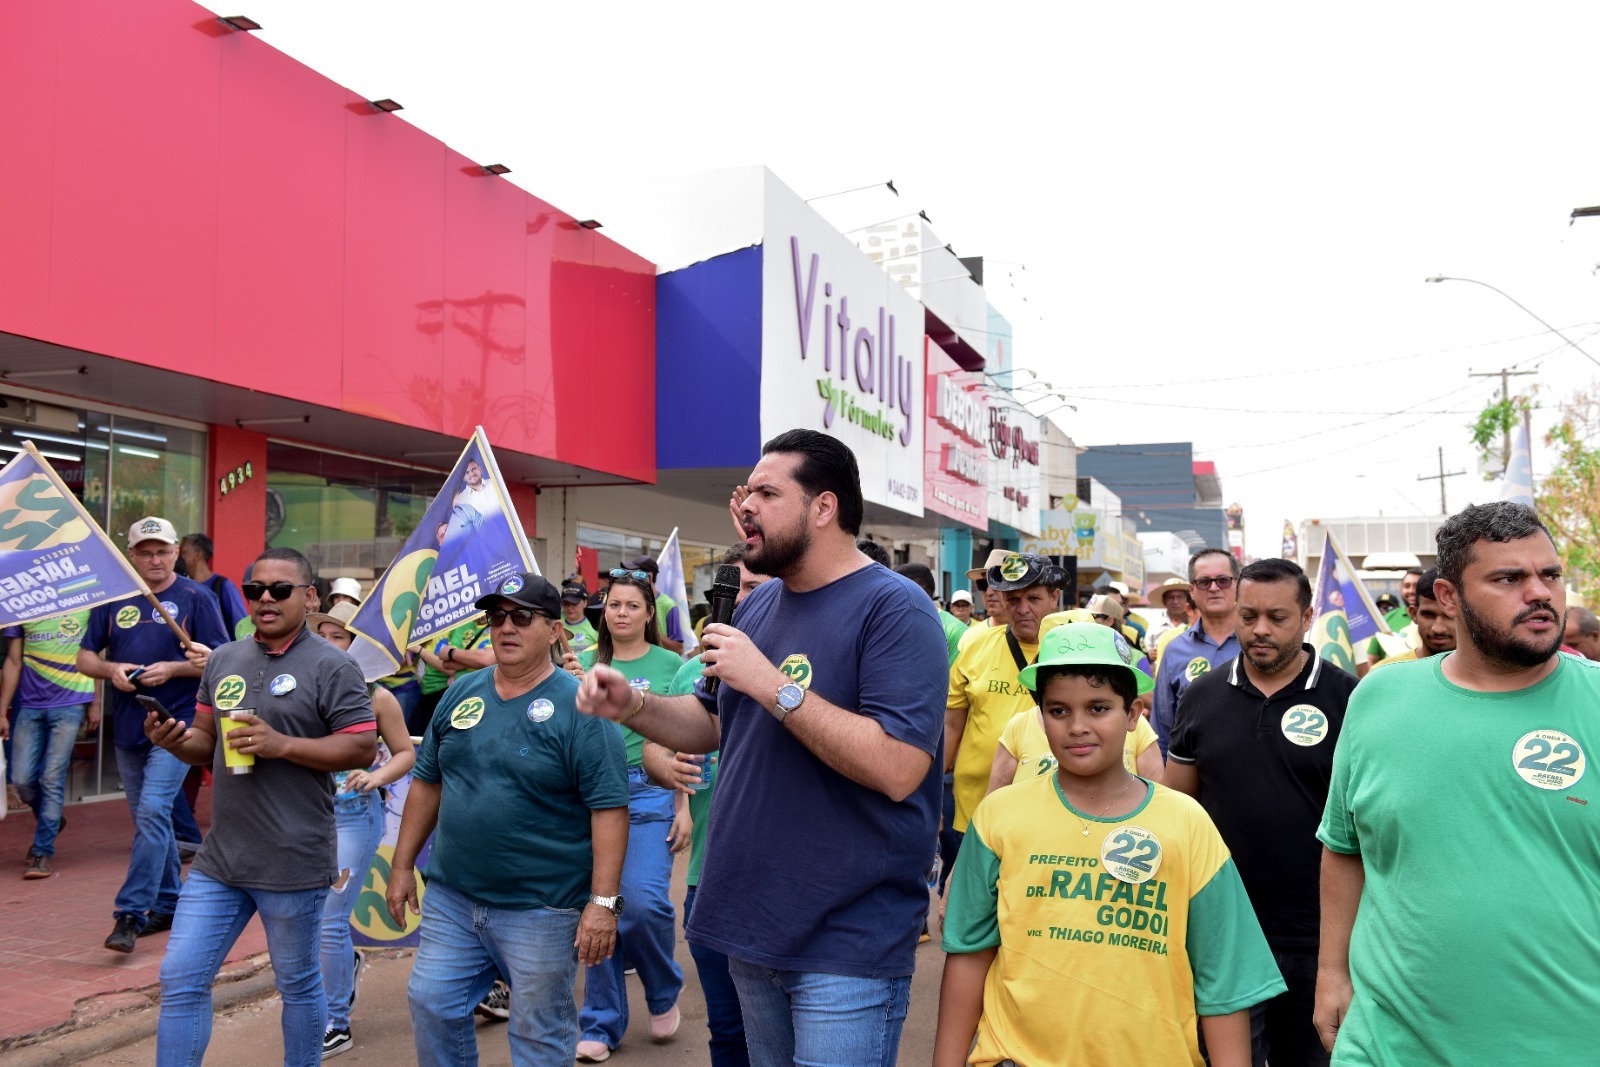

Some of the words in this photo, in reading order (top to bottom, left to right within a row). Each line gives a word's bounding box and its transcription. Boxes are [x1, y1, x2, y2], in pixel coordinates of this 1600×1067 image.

[790, 235, 912, 447] Vitally
[841, 390, 894, 441] Fórmulas
[219, 461, 253, 495] 4934
[1003, 558, 1026, 573] 22
[424, 563, 478, 600] AEL
[118, 609, 139, 622] 22
[420, 581, 482, 620] GODOI
[1058, 635, 1095, 654] 22
[1190, 660, 1208, 676] 22
[217, 681, 244, 700] 22
[453, 701, 483, 721] 22
[1284, 711, 1325, 737] 22
[1518, 738, 1580, 777] 22
[1029, 855, 1098, 867] PREFEITO
[1104, 833, 1159, 873] 22
[1026, 886, 1047, 897] DR.
[1049, 870, 1167, 912] RAFAEL
[1097, 904, 1168, 937] GODOI
[1049, 927, 1104, 944] THIAGO
[1108, 933, 1168, 956] MOREIRA
